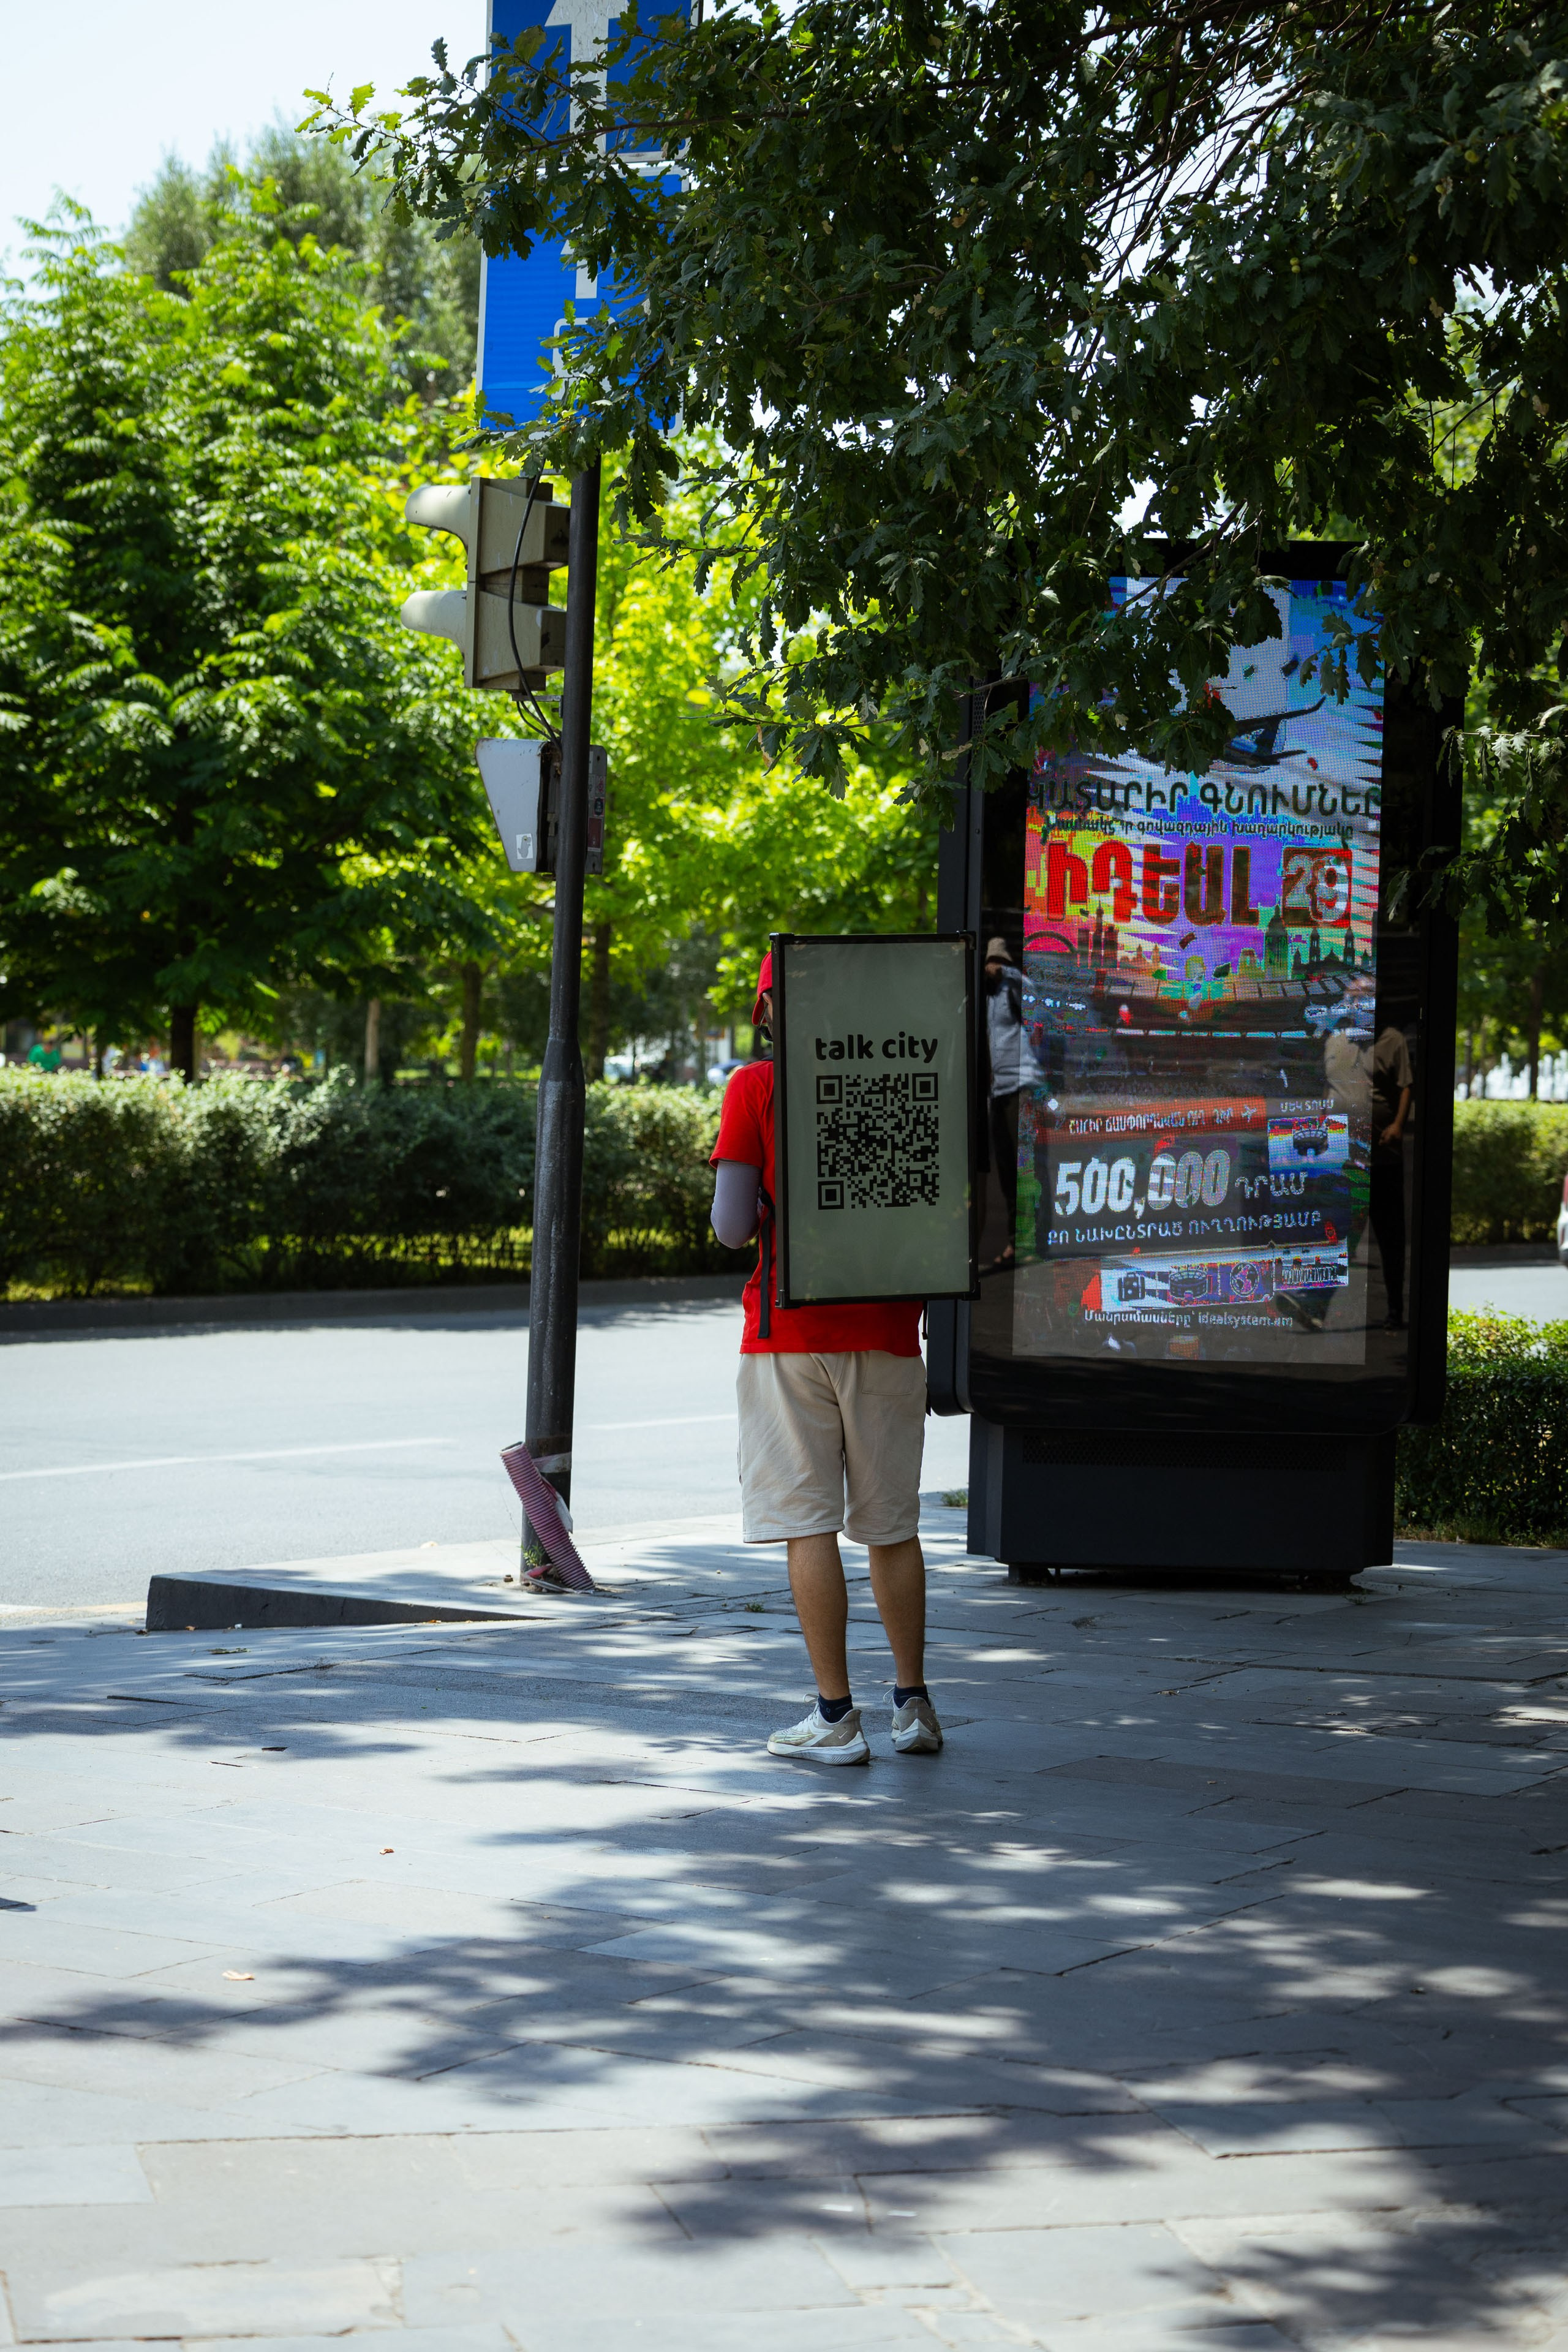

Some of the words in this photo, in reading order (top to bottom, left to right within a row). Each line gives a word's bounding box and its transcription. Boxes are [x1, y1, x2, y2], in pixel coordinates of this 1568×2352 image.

[815, 1034, 874, 1060] talk
[882, 1031, 938, 1064] city
[1054, 1150, 1231, 1219] 500,000
[1234, 1170, 1308, 1199] ԴՐԱՄ
